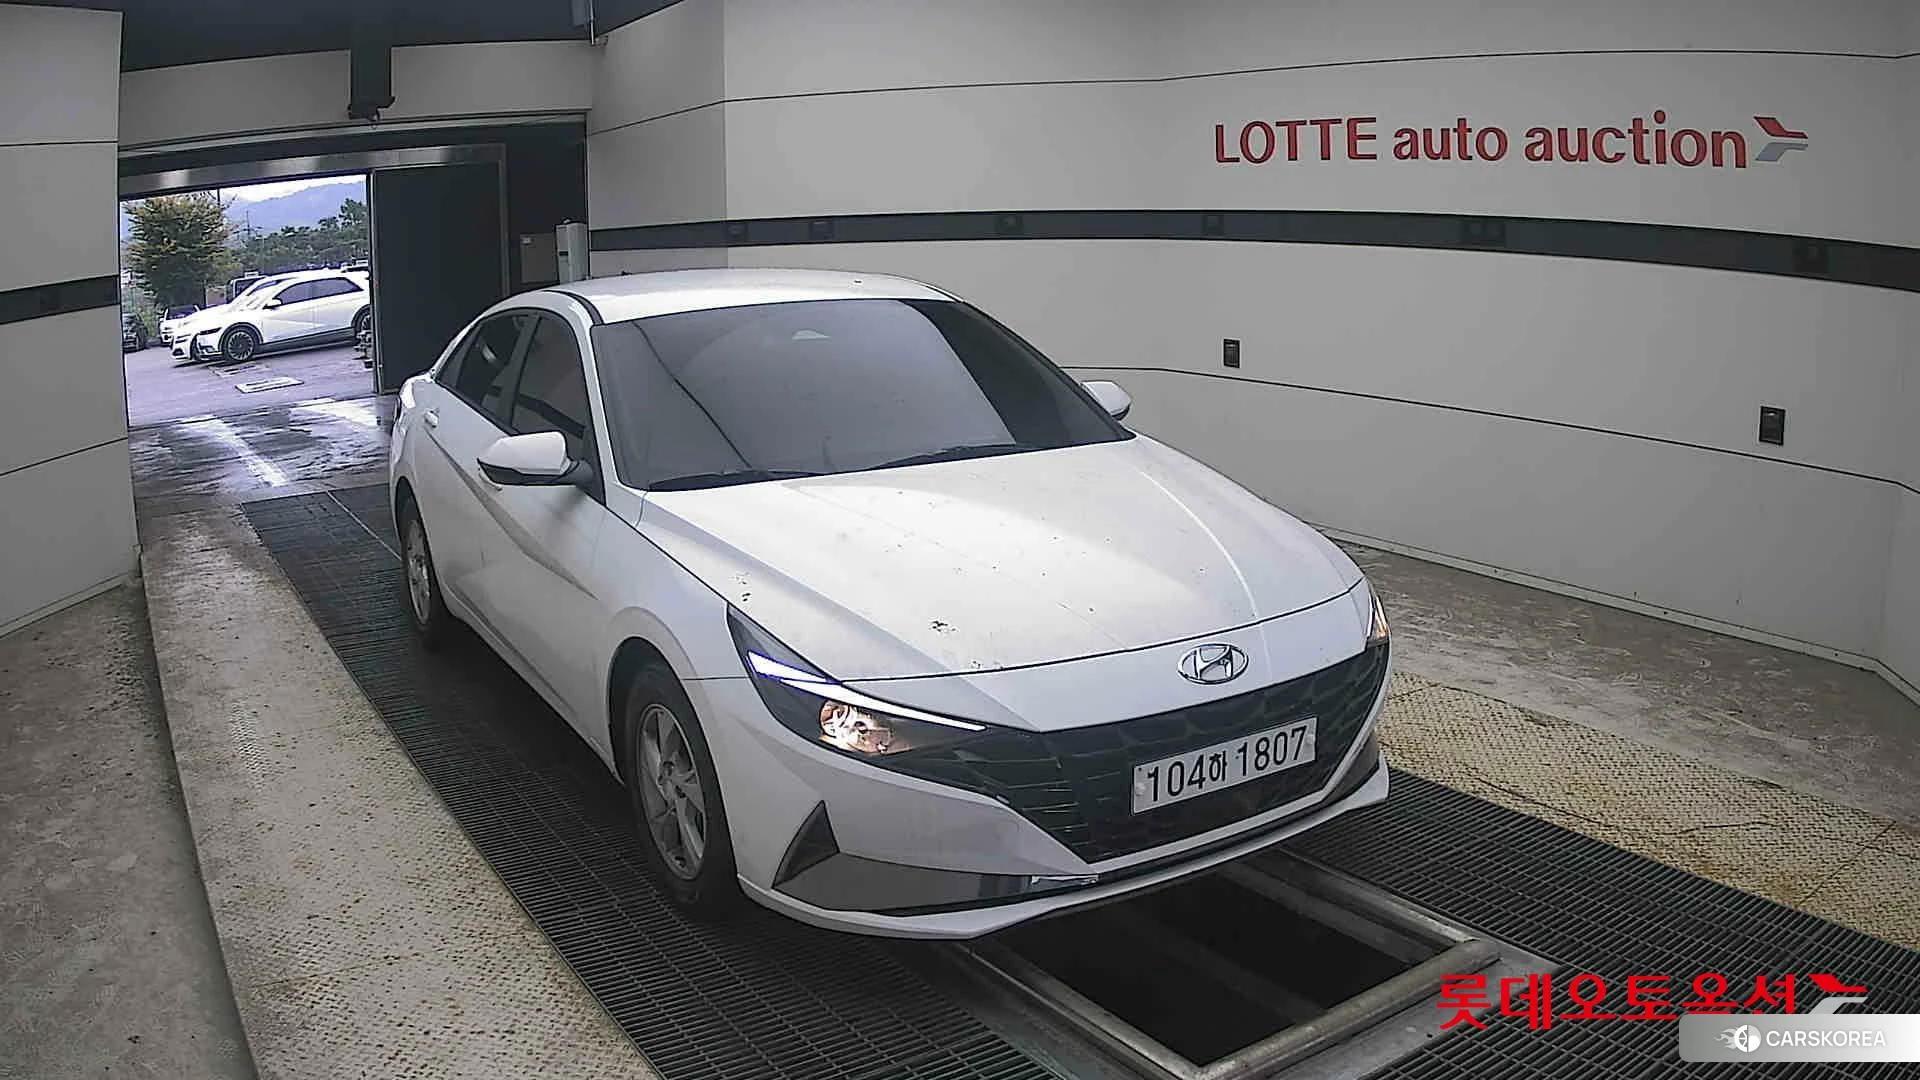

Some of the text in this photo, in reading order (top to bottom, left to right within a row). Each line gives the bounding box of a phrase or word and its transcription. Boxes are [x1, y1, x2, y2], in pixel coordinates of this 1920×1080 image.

[1215, 110, 1747, 168] LOTTE auto auction
[1147, 725, 1308, 801] 104하 1807
